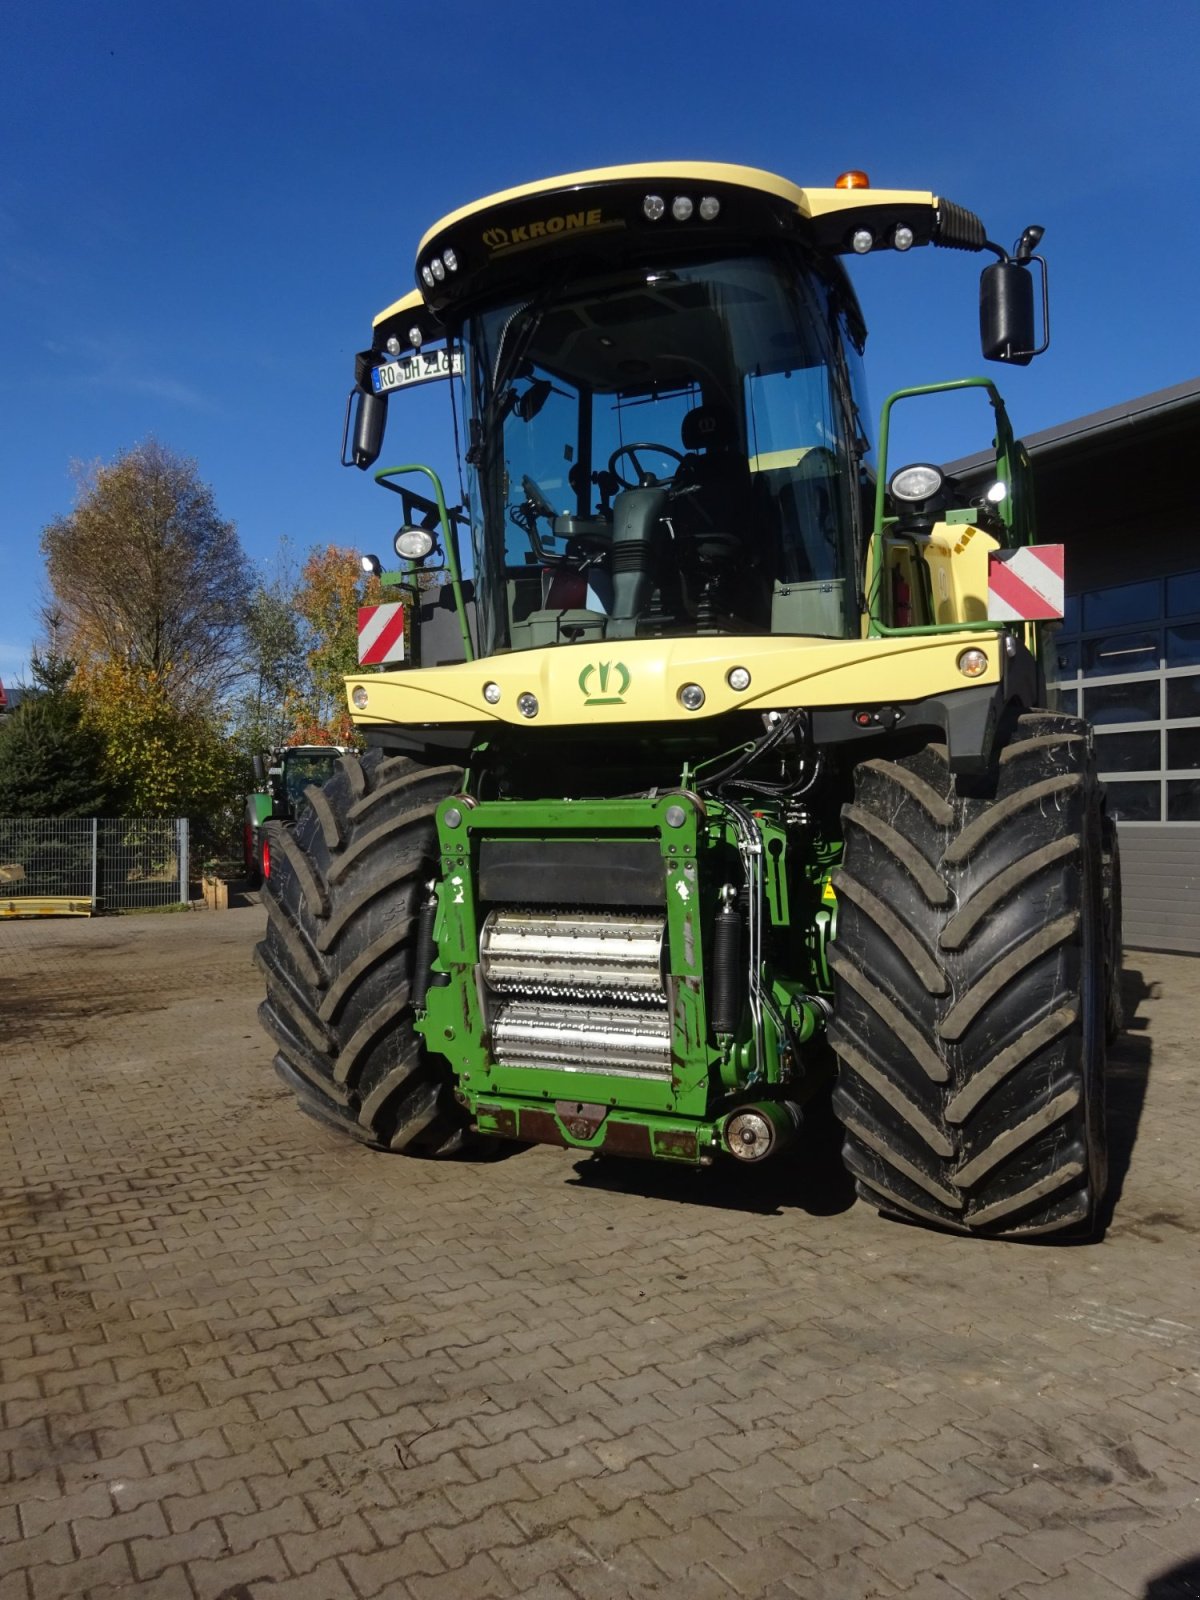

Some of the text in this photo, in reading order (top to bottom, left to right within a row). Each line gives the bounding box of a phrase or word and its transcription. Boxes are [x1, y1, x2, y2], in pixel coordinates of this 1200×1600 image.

[511, 208, 602, 243] KRONE
[380, 366, 395, 387] RO
[404, 359, 420, 380] DH
